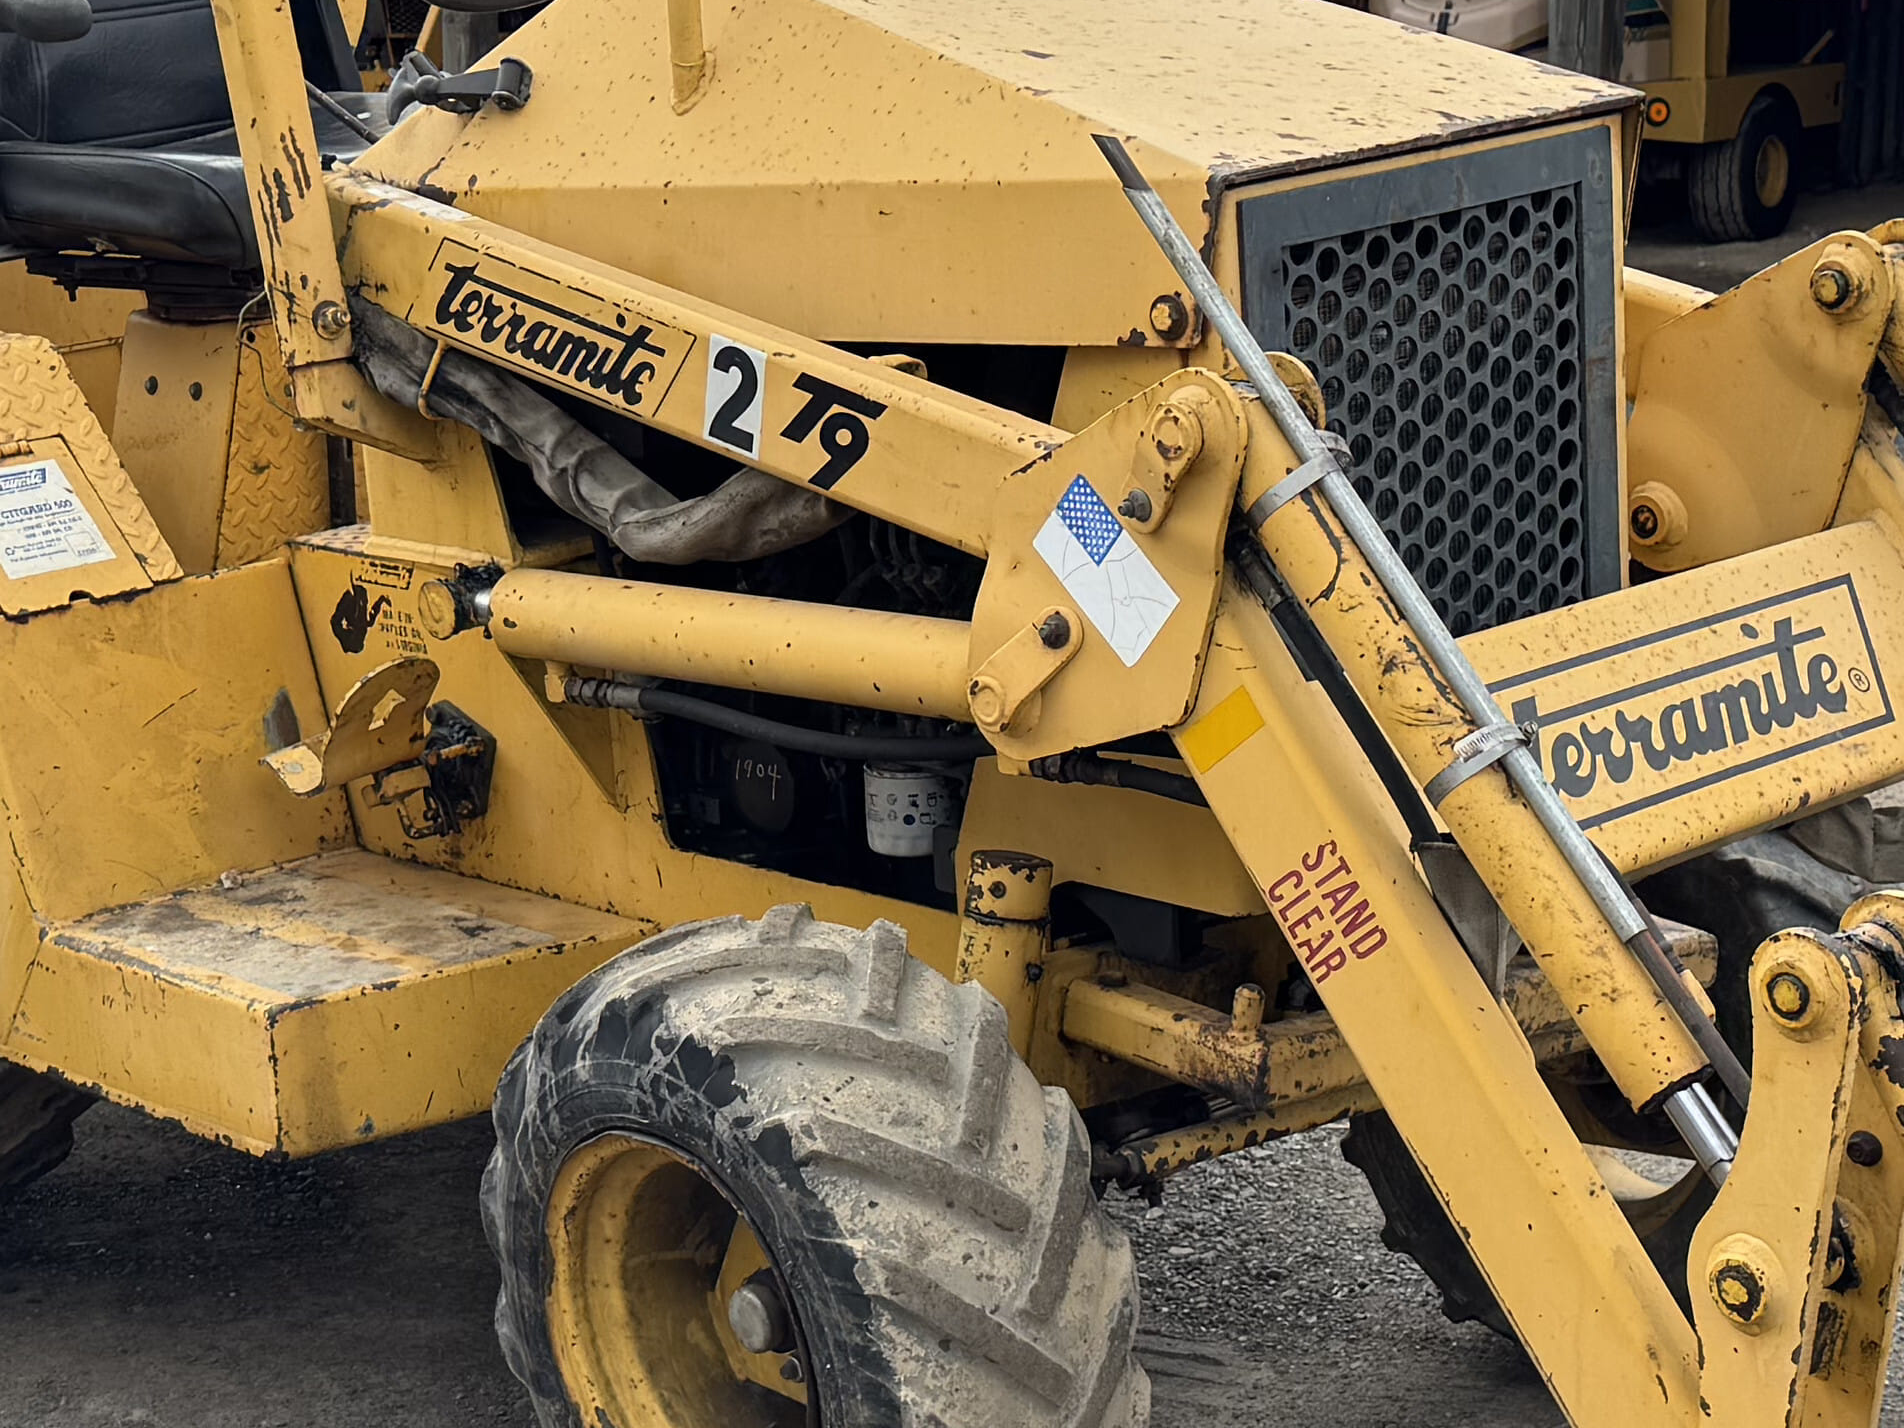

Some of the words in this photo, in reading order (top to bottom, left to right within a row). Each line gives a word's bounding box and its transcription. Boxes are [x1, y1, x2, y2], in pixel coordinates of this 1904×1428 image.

[434, 261, 667, 406] terramite
[709, 345, 761, 453] 2
[781, 372, 888, 490] T9
[1511, 617, 1847, 798] terramite
[735, 758, 782, 801] 1904
[1268, 870, 1347, 984] CLEAR
[1301, 839, 1388, 960] STAND
